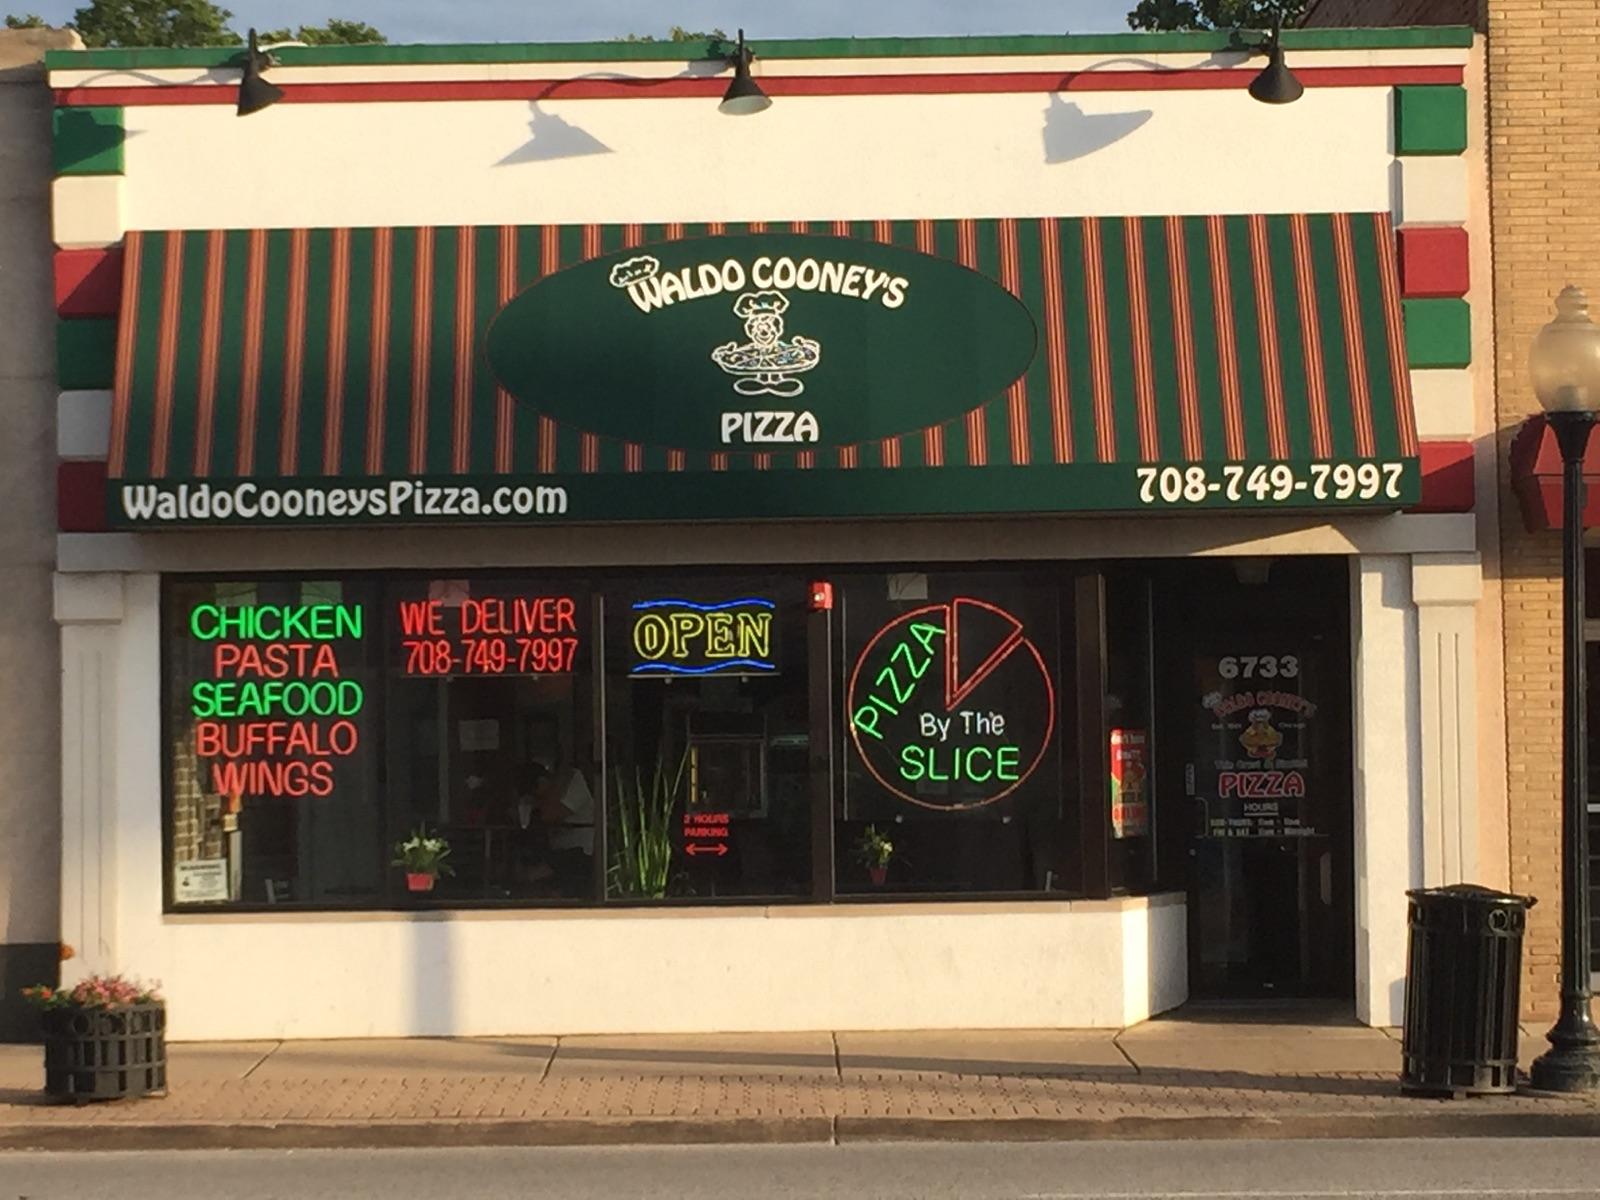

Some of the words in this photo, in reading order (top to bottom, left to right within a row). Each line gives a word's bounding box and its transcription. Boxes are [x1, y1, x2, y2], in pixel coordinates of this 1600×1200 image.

[628, 258, 746, 314] WALDO
[751, 256, 910, 309] COONEY'S
[720, 410, 820, 443] PIZZA
[122, 480, 569, 520] WaldoCooneysPizza.com
[1136, 462, 1403, 503] 708-749-7997
[190, 604, 363, 641] CHICKEN
[400, 600, 447, 636] WE
[461, 597, 577, 635] DELIVER
[633, 612, 773, 660] OPEN
[214, 643, 340, 678] PASTA
[402, 637, 579, 675] 708-749-7997
[1218, 654, 1300, 679] 6733
[191, 680, 364, 718] SEAFOOD
[853, 621, 947, 740] PIZZA
[195, 720, 359, 758] BUFFALO
[919, 712, 951, 742] By
[959, 710, 1006, 736] The
[212, 760, 334, 797] WINGS
[900, 744, 1020, 783] SLICE
[1218, 770, 1306, 799] PIZZA
